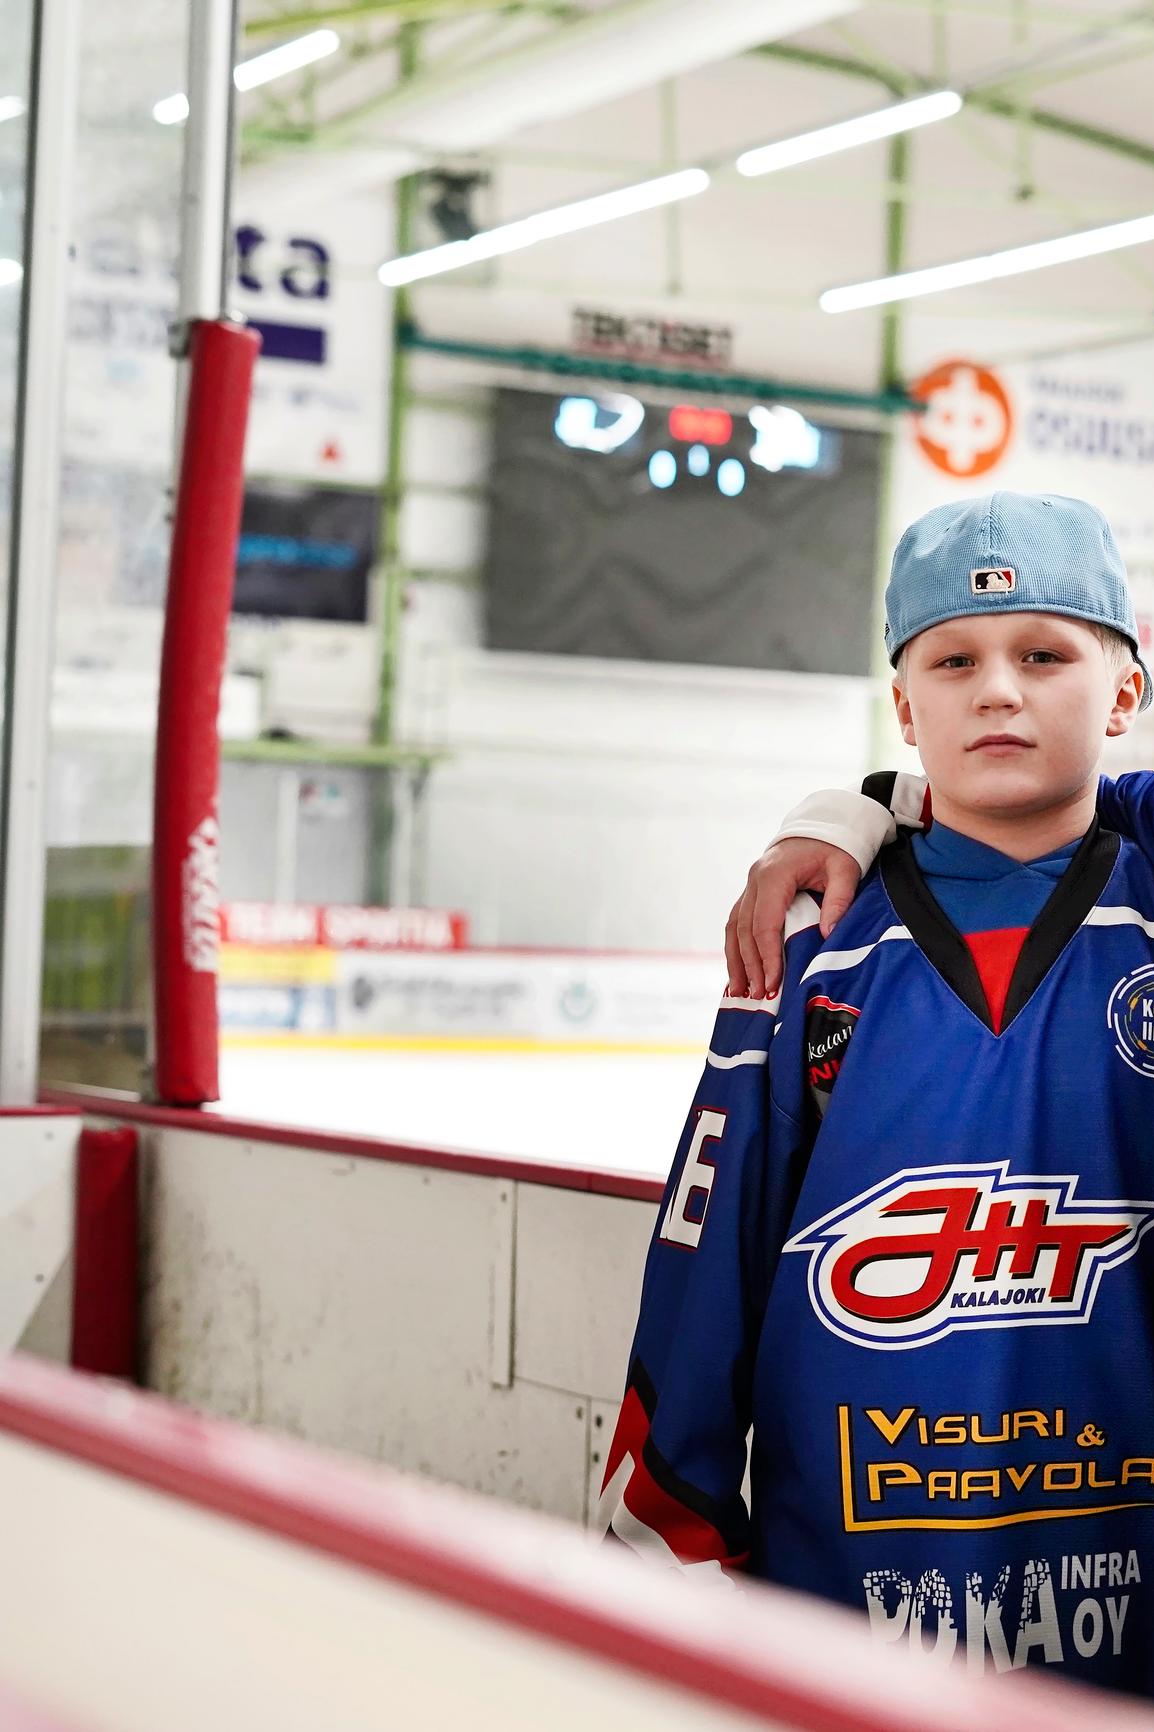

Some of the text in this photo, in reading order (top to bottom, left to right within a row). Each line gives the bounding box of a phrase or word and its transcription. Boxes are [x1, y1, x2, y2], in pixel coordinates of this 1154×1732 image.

[950, 1287, 1045, 1309] KALAJOKI
[865, 1407, 1107, 1448] VISURI &
[862, 1549, 1142, 1676] POKA INFRA
[1071, 1594, 1130, 1659] OY
